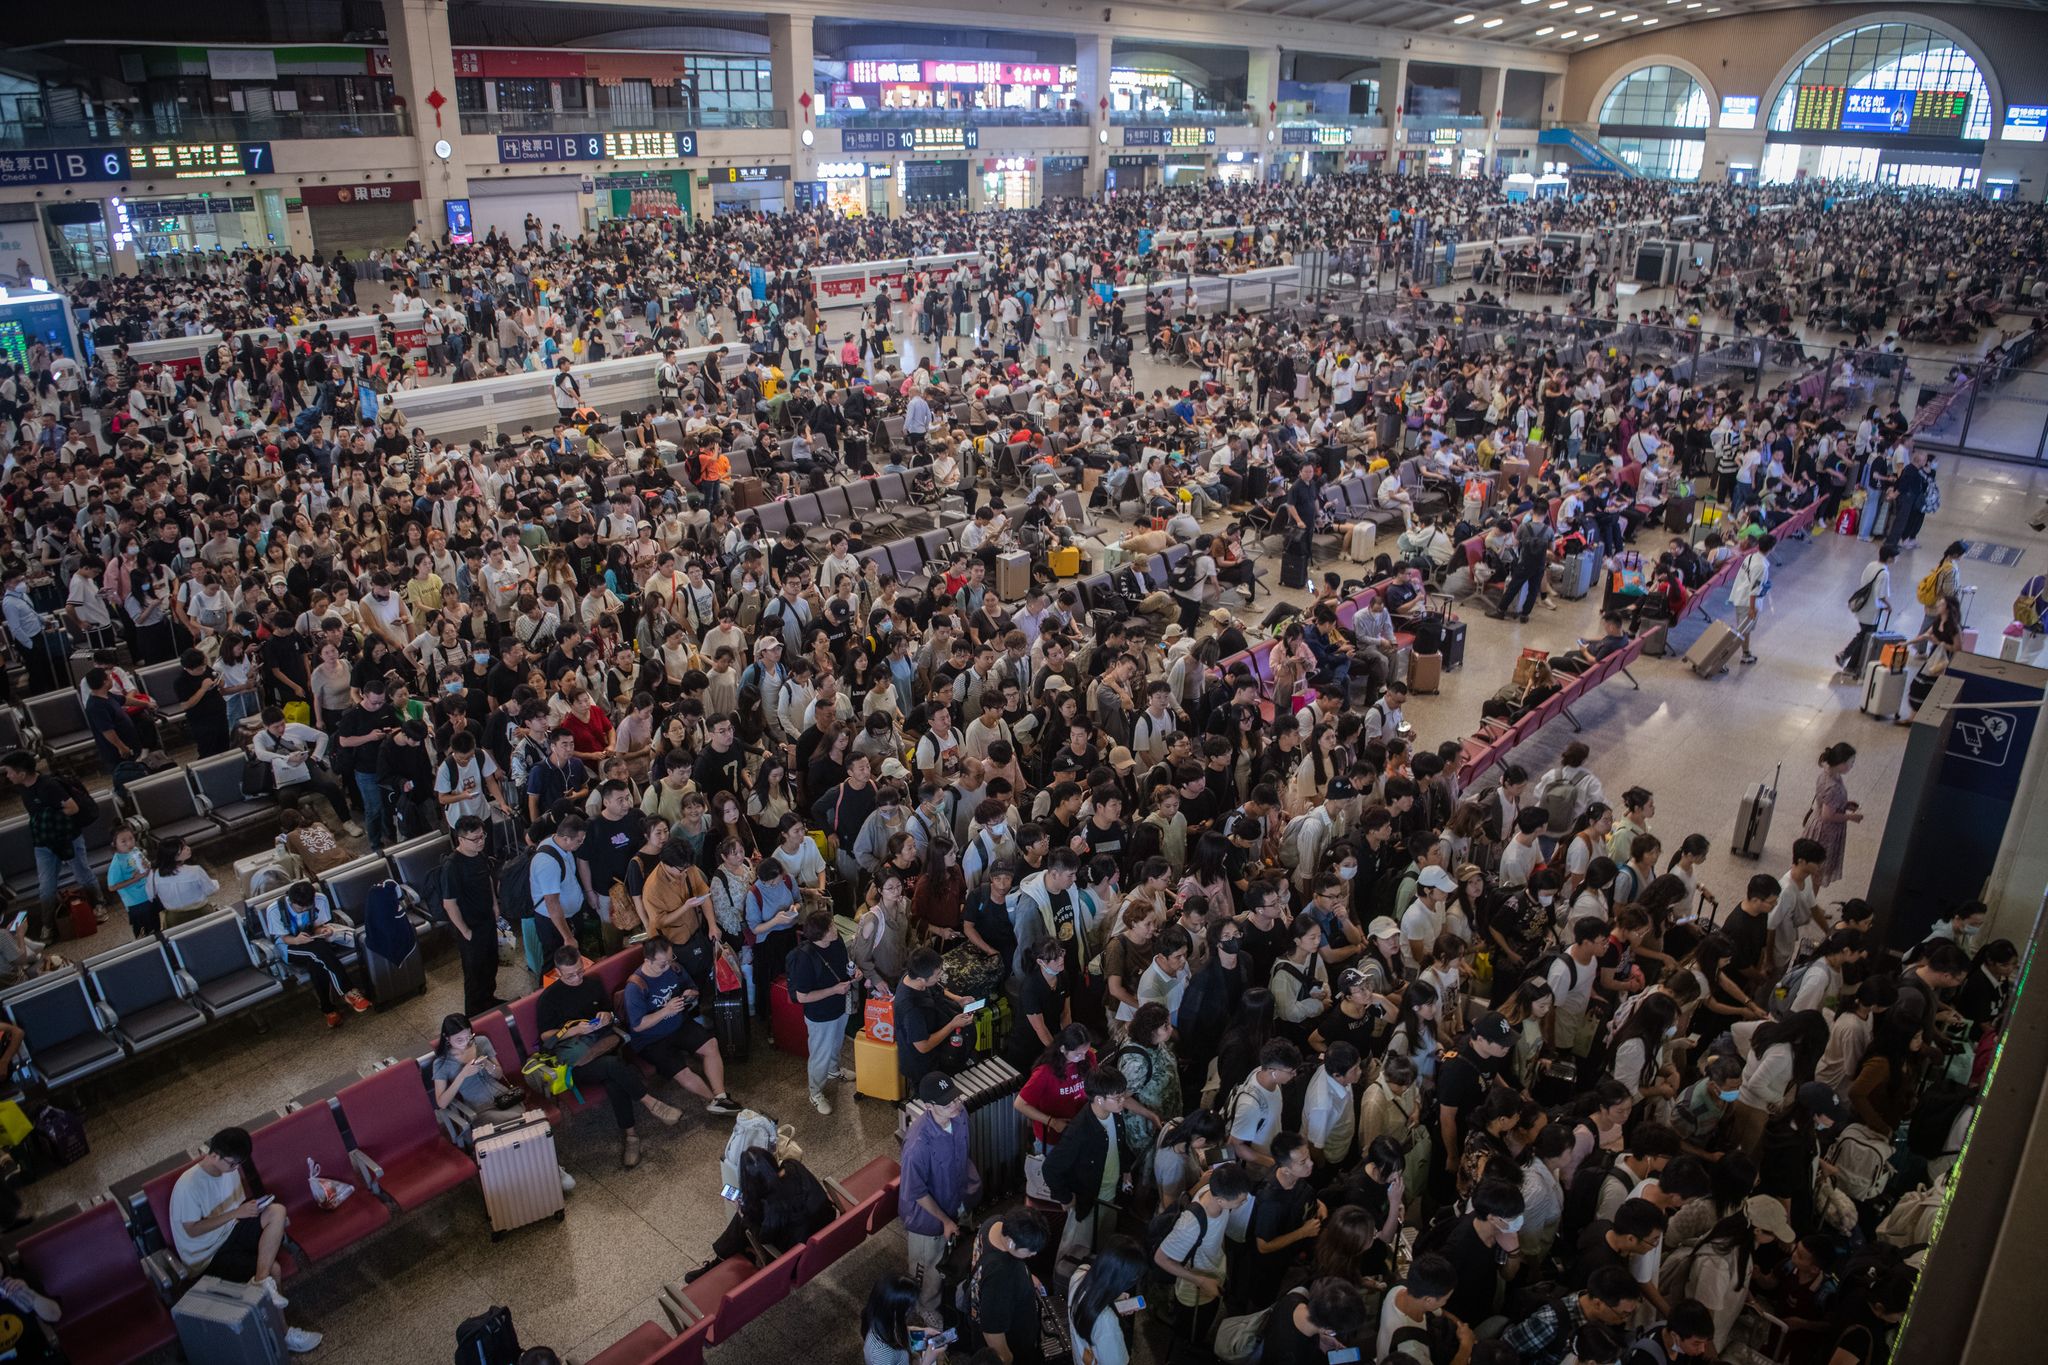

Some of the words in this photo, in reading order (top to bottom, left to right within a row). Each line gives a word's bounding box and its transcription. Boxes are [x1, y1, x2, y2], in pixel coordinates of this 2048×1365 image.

[887, 132, 896, 148] B
[901, 132, 913, 147] 10
[967, 132, 977, 146] 11
[1153, 130, 1160, 143] B
[1163, 130, 1172, 143] 12
[1206, 130, 1215, 143] 13
[521, 139, 553, 151] 检票口
[564, 138, 577, 157] B
[588, 138, 599, 155] 8
[682, 136, 692, 153] 9
[0, 157, 49, 172] 检票口
[66, 155, 87, 177] B
[104, 154, 120, 175] 6
[249, 148, 263, 169] 7
[1, 173, 28, 181] Check
[354, 186, 369, 201] 果
[1499, 1018, 1510, 1034] NY
[938, 1079, 949, 1091] NY
